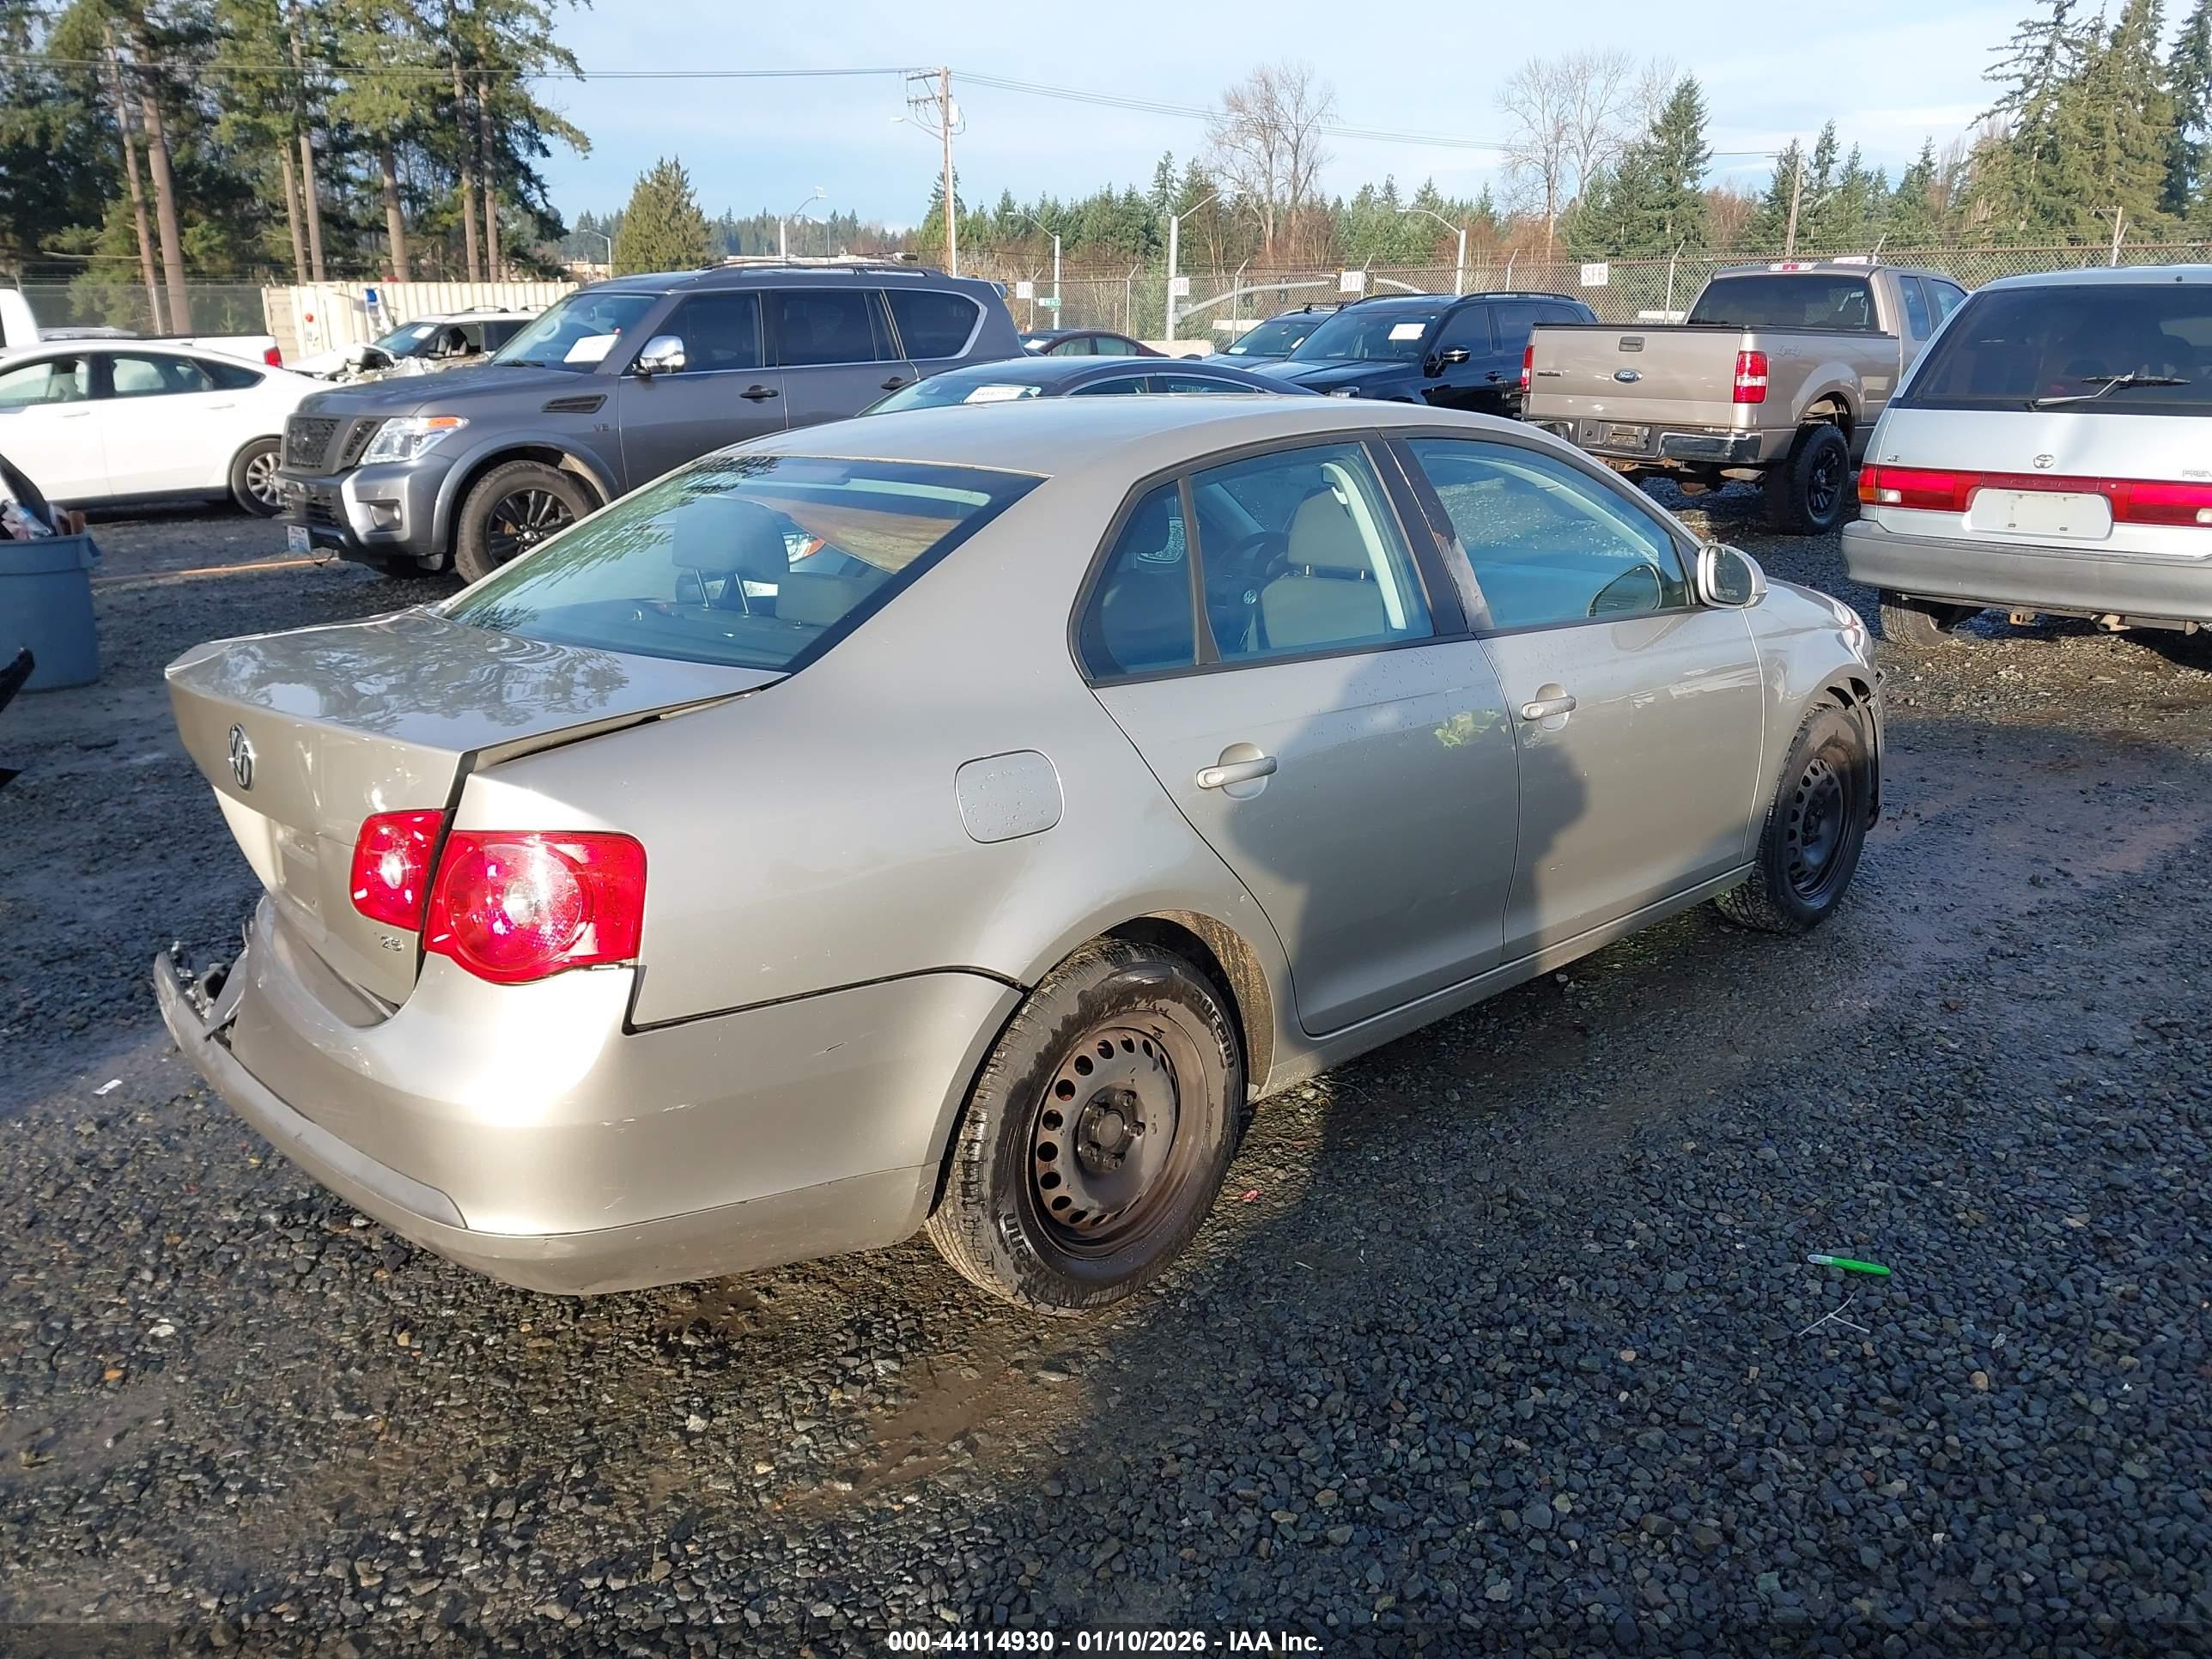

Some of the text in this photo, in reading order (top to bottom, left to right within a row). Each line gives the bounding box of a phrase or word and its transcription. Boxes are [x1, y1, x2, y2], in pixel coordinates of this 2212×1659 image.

[1343, 274, 1359, 290] SF7
[1583, 266, 1606, 283] SF6
[1173, 280, 1188, 293] SF8
